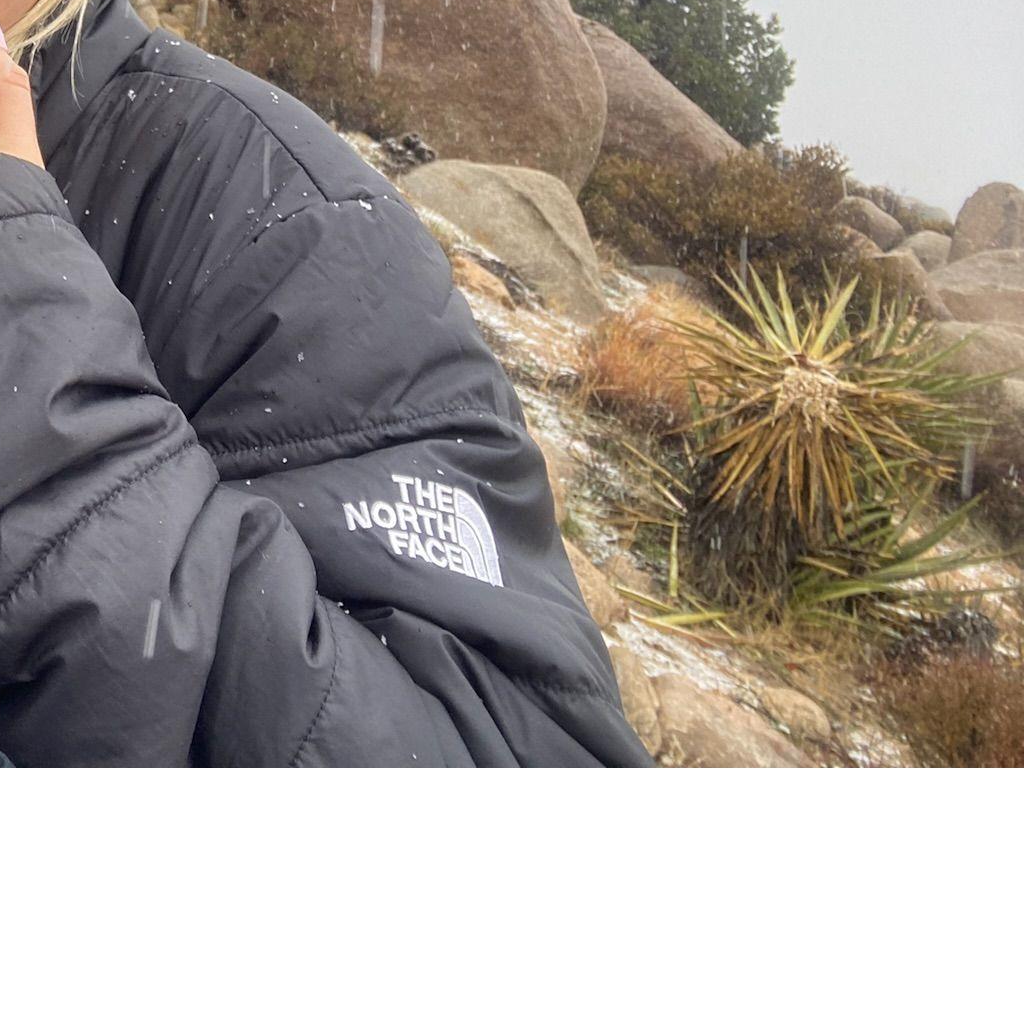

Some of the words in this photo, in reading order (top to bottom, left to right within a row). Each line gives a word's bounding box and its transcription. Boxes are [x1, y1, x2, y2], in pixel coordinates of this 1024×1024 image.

[391, 474, 455, 514] THE
[342, 500, 458, 544] NORTH
[388, 529, 466, 575] FACE
